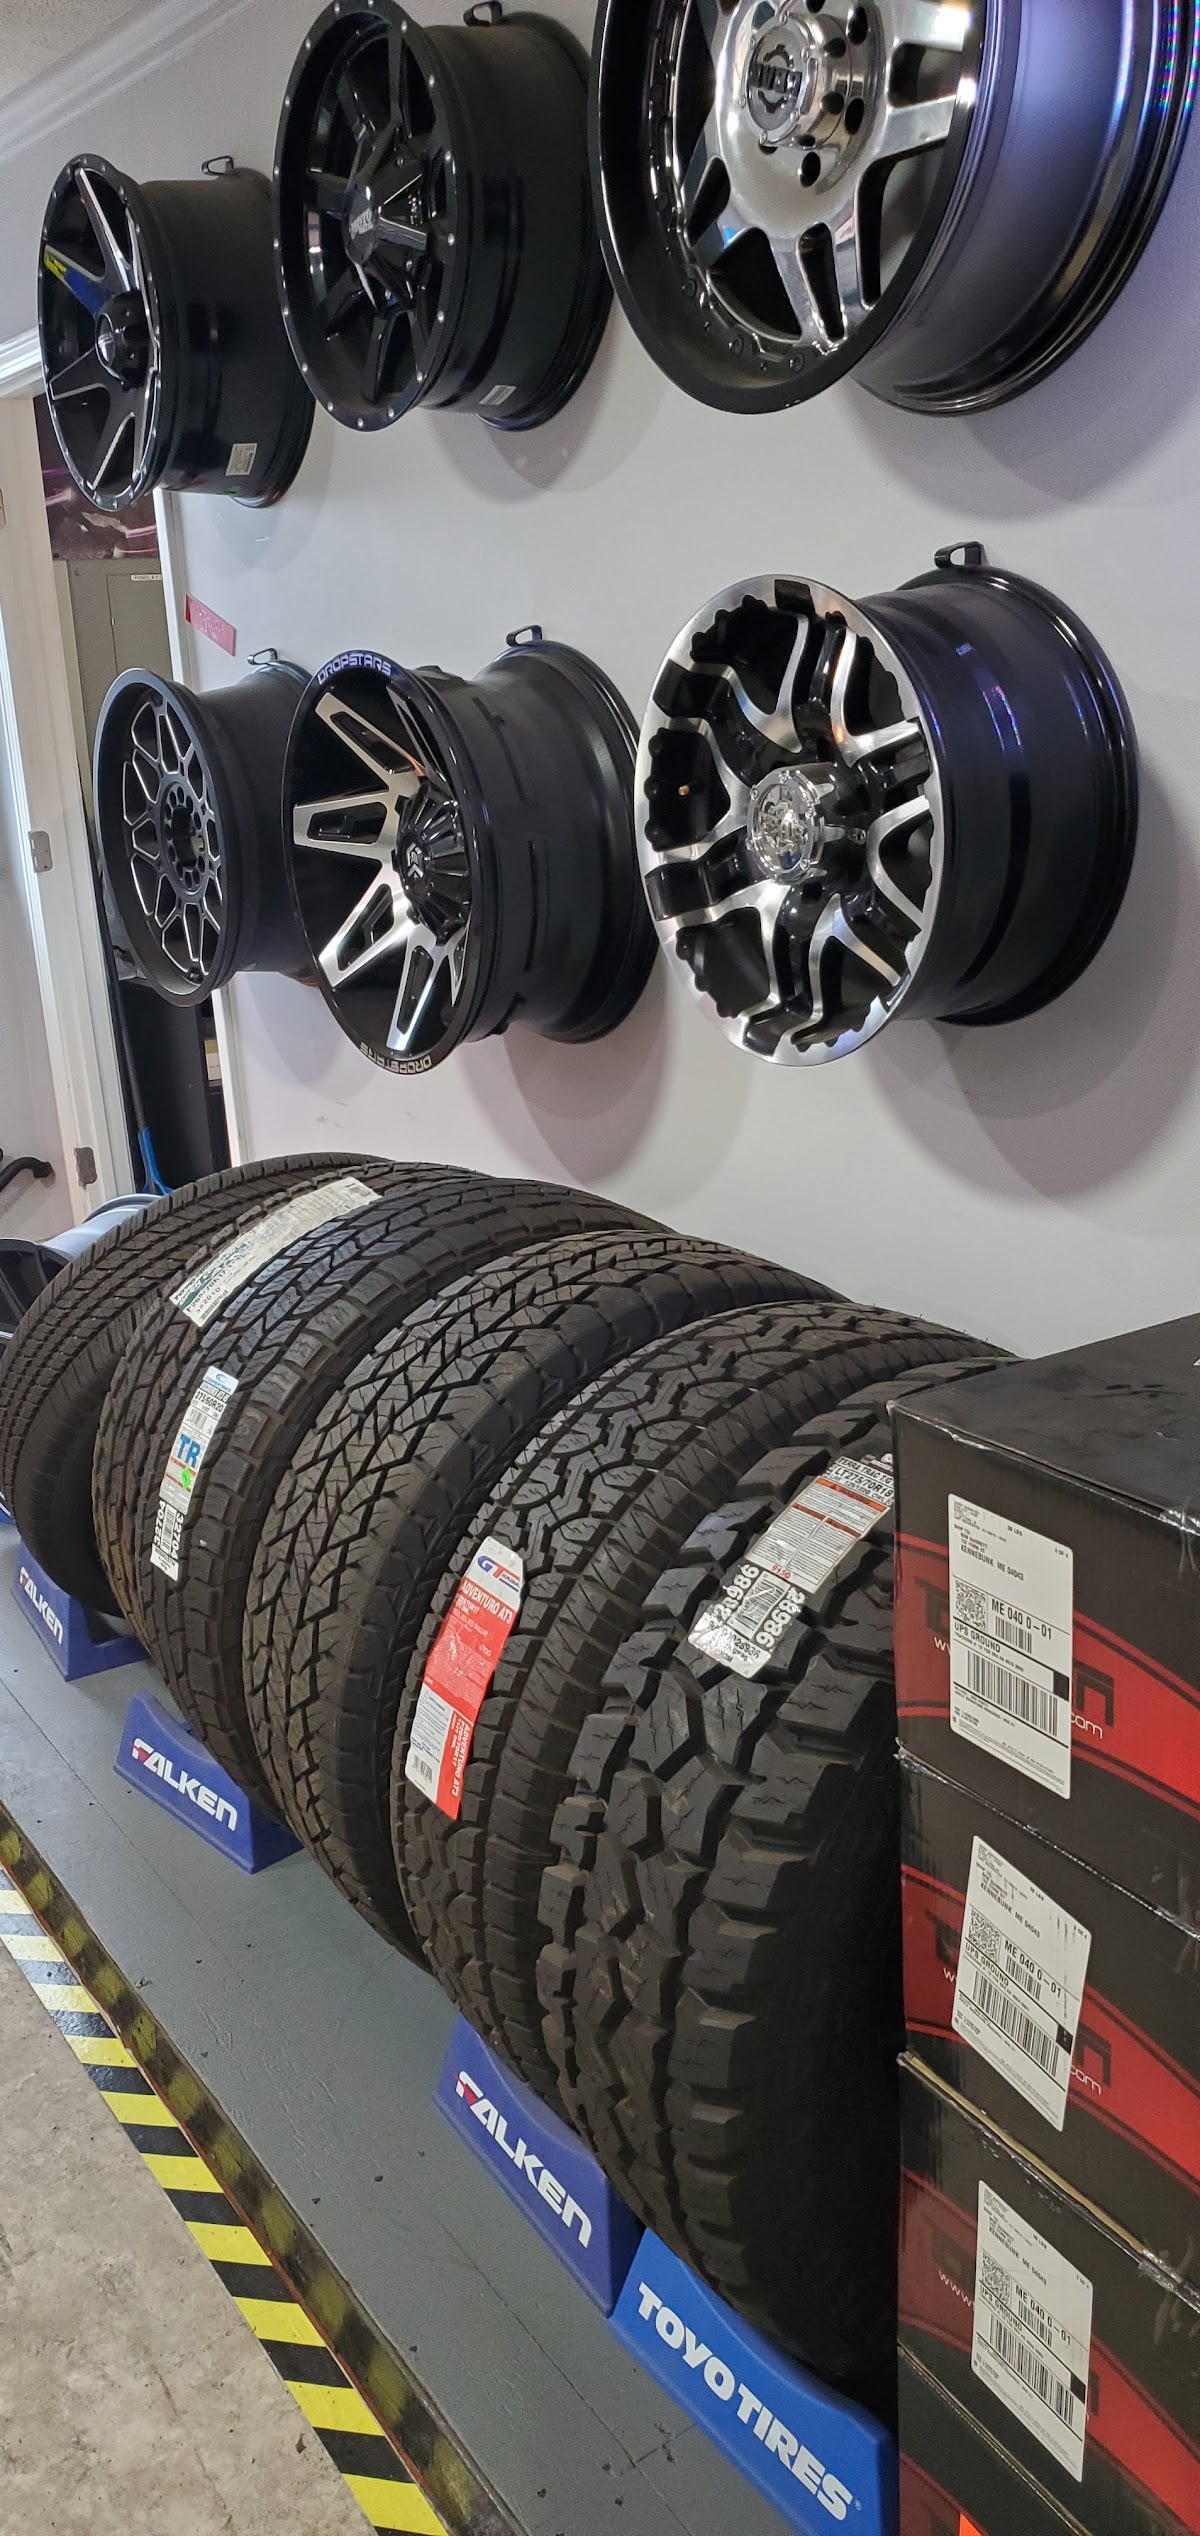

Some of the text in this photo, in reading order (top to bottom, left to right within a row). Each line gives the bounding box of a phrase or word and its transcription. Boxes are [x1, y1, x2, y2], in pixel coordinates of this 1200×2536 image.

[317, 652, 392, 685] DROPSTARS
[359, 1041, 433, 1074] DROPSTARS
[194, 1391, 224, 1412] 275/60R20
[176, 1433, 201, 1469] TR
[839, 1457, 861, 1472] TERRA
[861, 1466, 881, 1480] TRAC
[835, 1467, 894, 1497] LT275/70R18
[154, 1500, 166, 1546] 32704
[170, 1512, 184, 1560] 32704
[477, 1555, 520, 1578] GT
[771, 1564, 792, 1579] 9150
[961, 1544, 1023, 1581] KENNEBUNK ME 04043
[19, 1566, 64, 1645] FALKEN
[460, 1581, 513, 1624] ADVENTURO AT3
[756, 1587, 806, 1648] 28986
[991, 1598, 1004, 1616] ME
[1007, 1606, 1022, 1626] 040
[954, 1621, 1000, 1653] UPS GROUND
[451, 1723, 470, 1796] ADVENTURO AT3
[131, 1738, 238, 1832] FALKEN
[980, 1881, 1011, 1914] KENNEBUNK
[1014, 1911, 1023, 1923] ME
[965, 1941, 1009, 1987] UPS GROUND
[1004, 1938, 1017, 1959] ME
[1018, 1952, 1034, 1974] 040
[454, 2070, 592, 2249] FALKEN
[994, 2298, 1022, 2332] GROUND
[1015, 2283, 1027, 2304] ME
[1030, 2298, 1044, 2321] 040
[638, 2281, 853, 2521] TOYO TIRES
